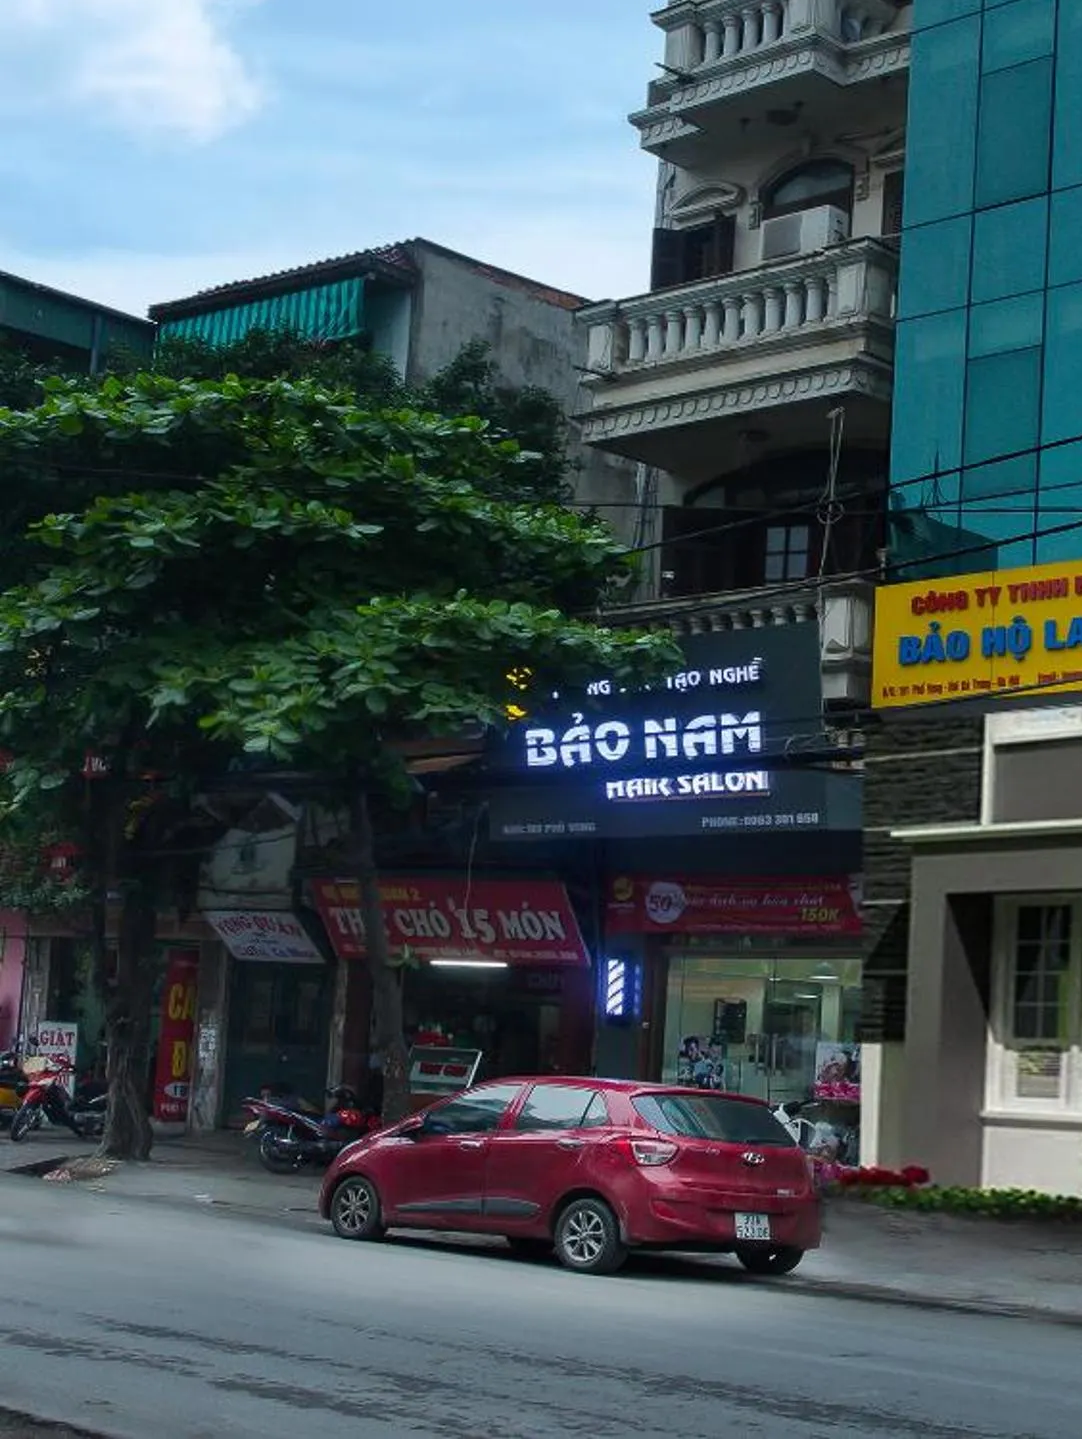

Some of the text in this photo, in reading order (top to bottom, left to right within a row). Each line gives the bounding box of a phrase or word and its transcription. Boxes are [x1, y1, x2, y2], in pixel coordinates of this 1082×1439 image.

[911, 589, 968, 615] CÔNG
[974, 586, 1001, 608] TY
[1008, 577, 1067, 603] TNHH
[899, 620, 970, 665] BẢO
[982, 616, 1032, 661] HỘ
[525, 711, 761, 767] BẢO NAM
[676, 771, 769, 795] SALON
